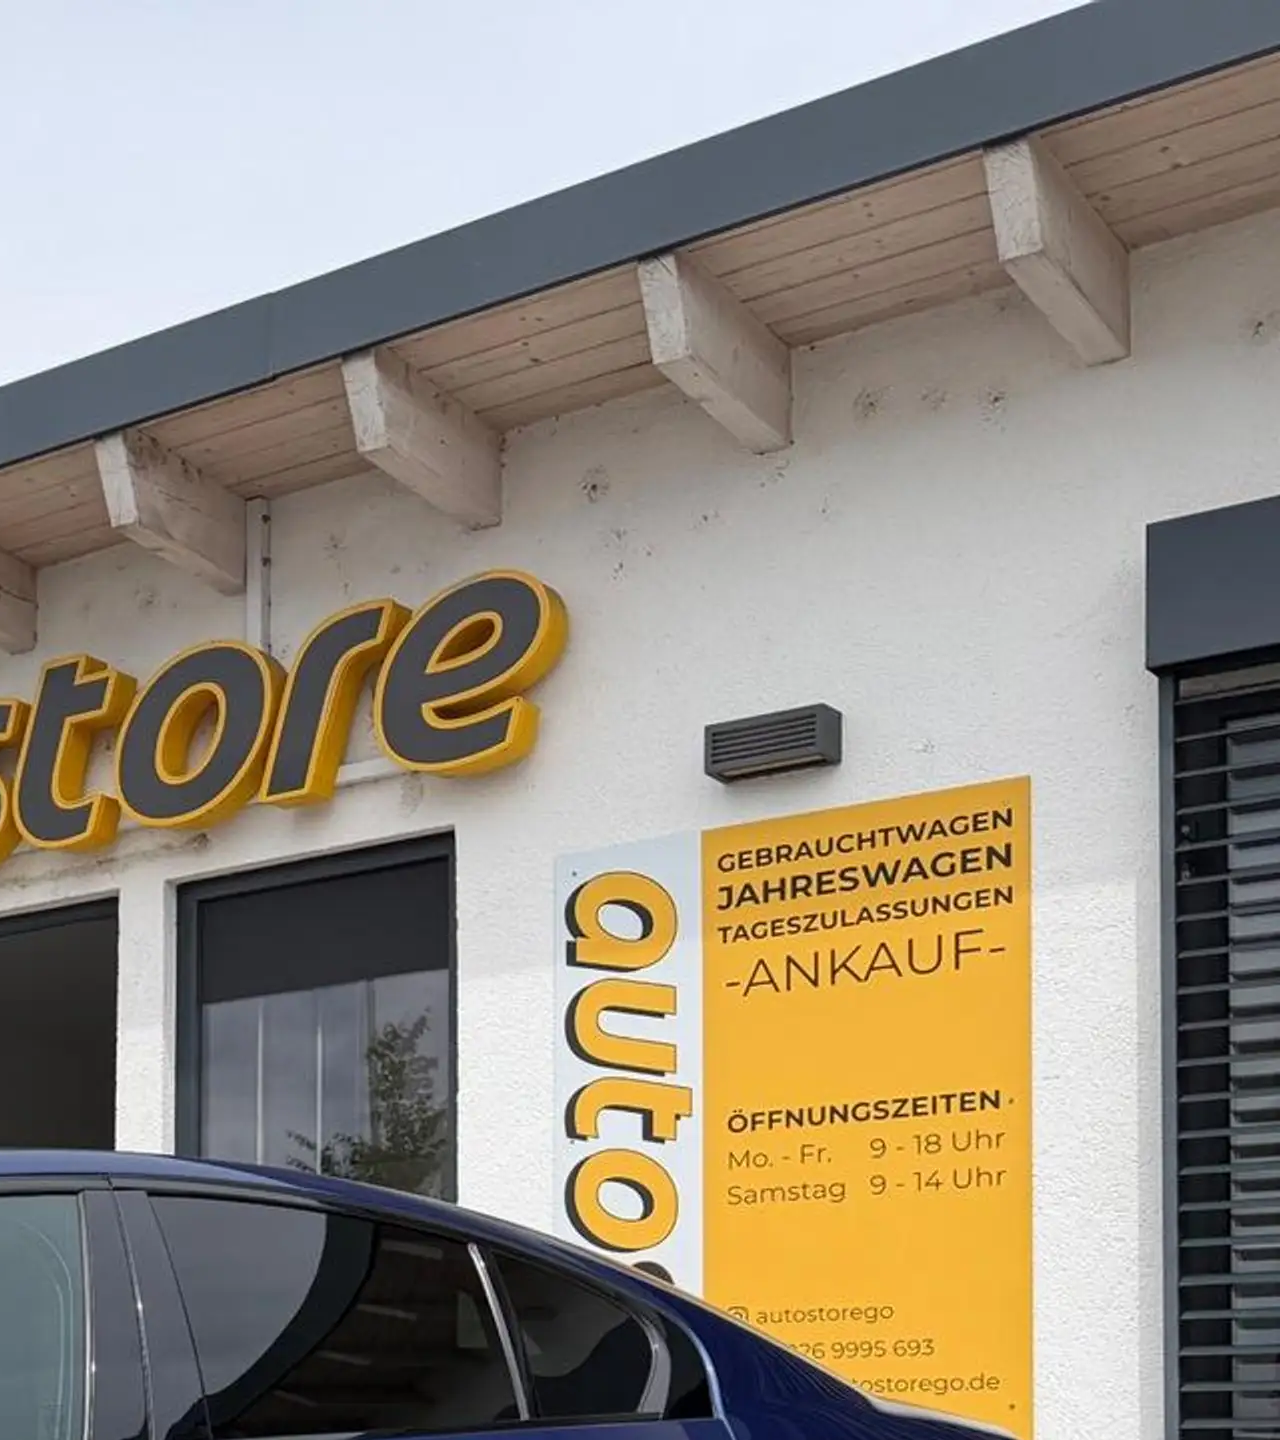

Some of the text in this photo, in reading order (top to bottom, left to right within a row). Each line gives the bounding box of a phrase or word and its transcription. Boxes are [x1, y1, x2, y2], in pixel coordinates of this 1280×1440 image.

[716, 807, 1013, 874] GEBRAUCHTWAGEN
[716, 842, 1013, 911] JAHRESWAGEN
[717, 885, 1013, 945] TAGESZULASSUNGEN
[725, 928, 1006, 998] -ANKAUF-
[563, 869, 694, 1286] auto
[727, 1089, 1000, 1133] ÖFFNUNGSZEITEN
[727, 1149, 774, 1170] Mo.
[799, 1143, 833, 1165] Fr.
[869, 1137, 887, 1159] 9
[913, 1133, 943, 1155] 18
[951, 1129, 1006, 1152] Uhr
[727, 1181, 847, 1205] Samstag
[869, 1174, 887, 1196] 9
[913, 1170, 943, 1192] 14
[952, 1166, 1007, 1189] Uhr
[756, 1305, 895, 1327] autostorego
[831, 1339, 887, 1359] 9995
[893, 1337, 935, 1358] 693
